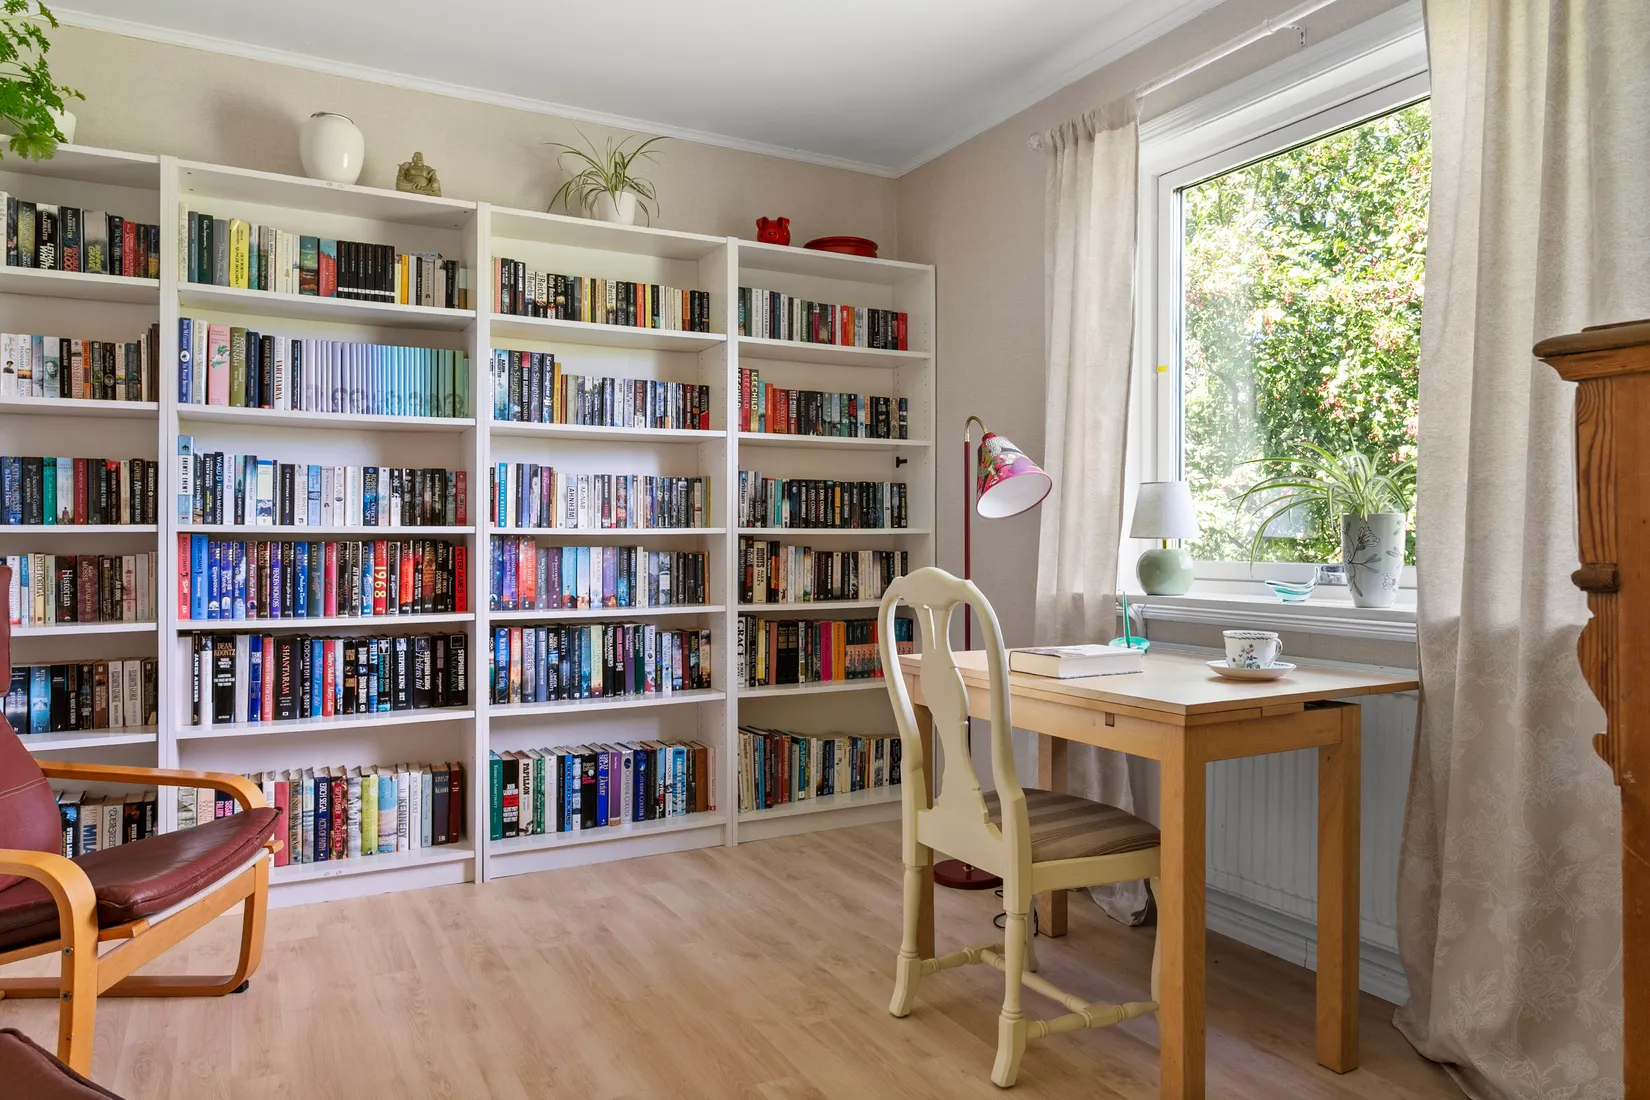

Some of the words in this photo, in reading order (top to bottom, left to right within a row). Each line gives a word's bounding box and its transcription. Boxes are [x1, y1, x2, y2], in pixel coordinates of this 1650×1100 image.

[537, 278, 546, 300] Reichs
[756, 548, 765, 568] ROOTS
[62, 570, 73, 607] Historian
[374, 566, 386, 598] 1968
[282, 645, 290, 694] SHANTARAM
[348, 790, 359, 832] CAPOTE
[399, 799, 407, 838] KENNEDY
